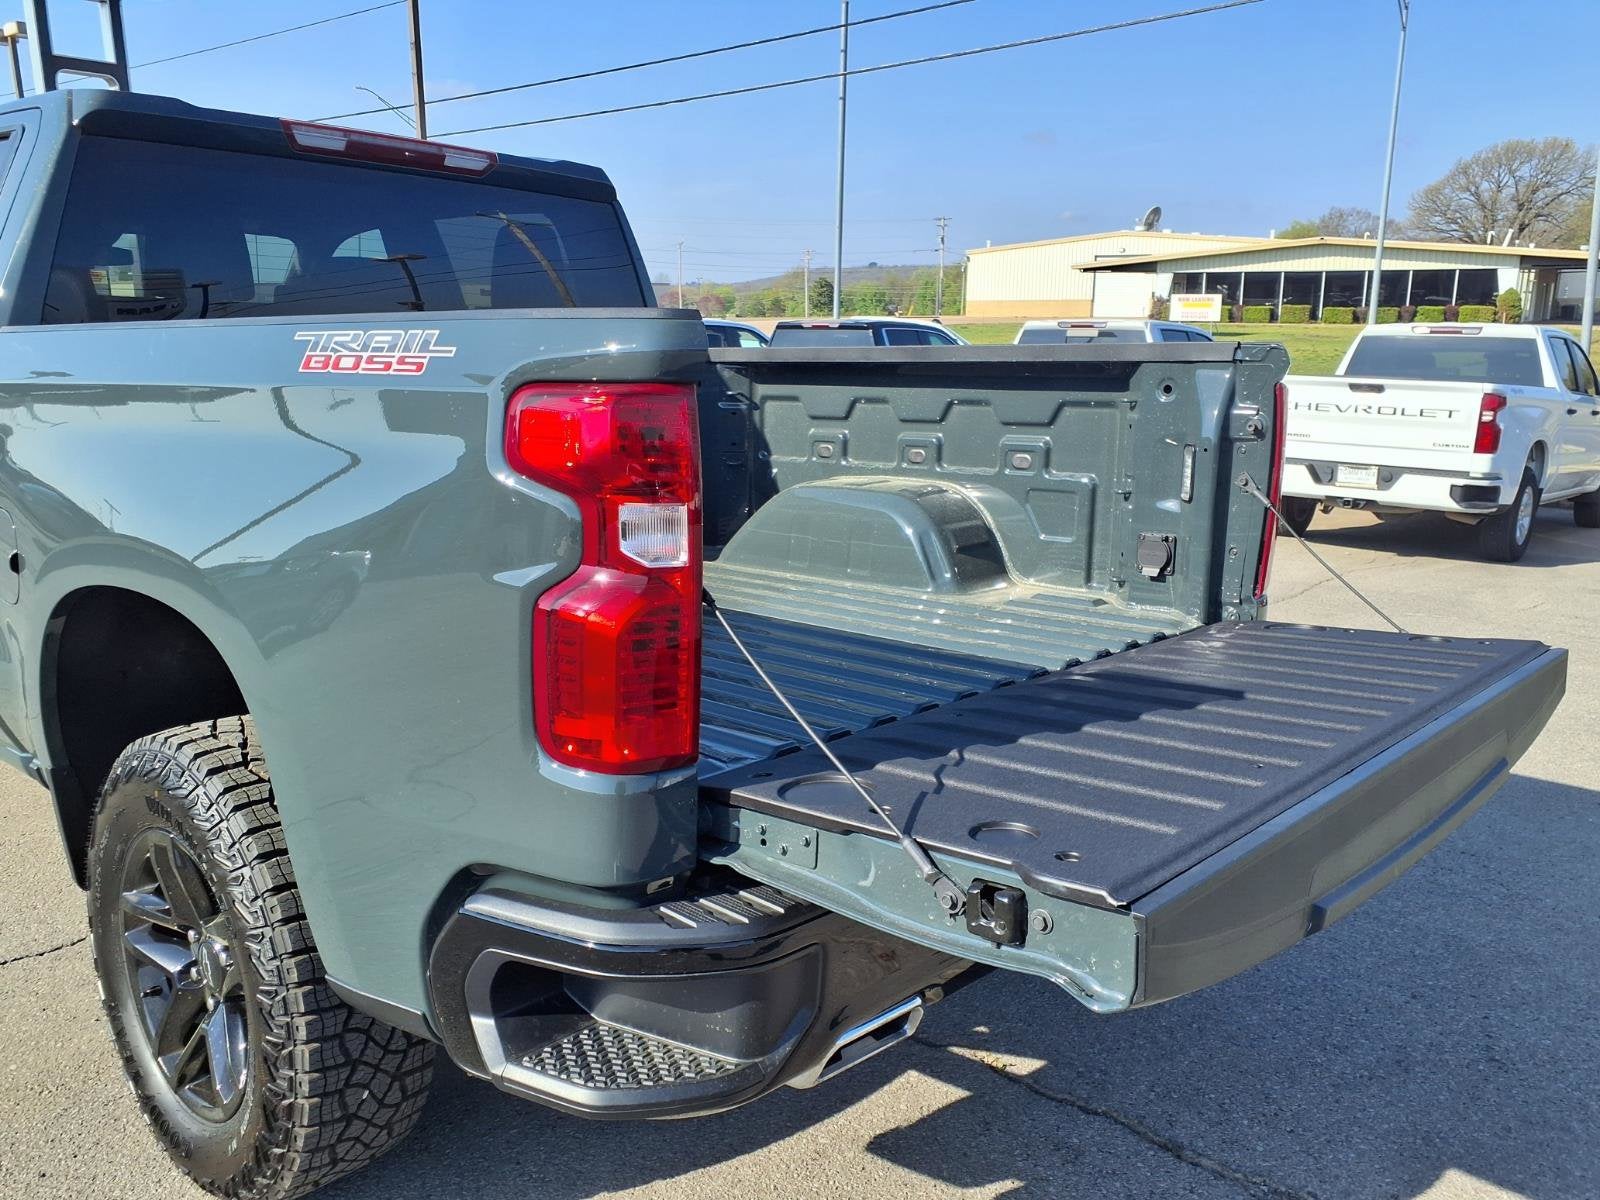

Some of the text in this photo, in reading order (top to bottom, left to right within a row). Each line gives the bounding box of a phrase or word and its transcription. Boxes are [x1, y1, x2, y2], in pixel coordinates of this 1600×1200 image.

[294, 330, 457, 357] TRAIL
[298, 353, 430, 376] BOSS
[1288, 401, 1460, 419] HEVROLET
